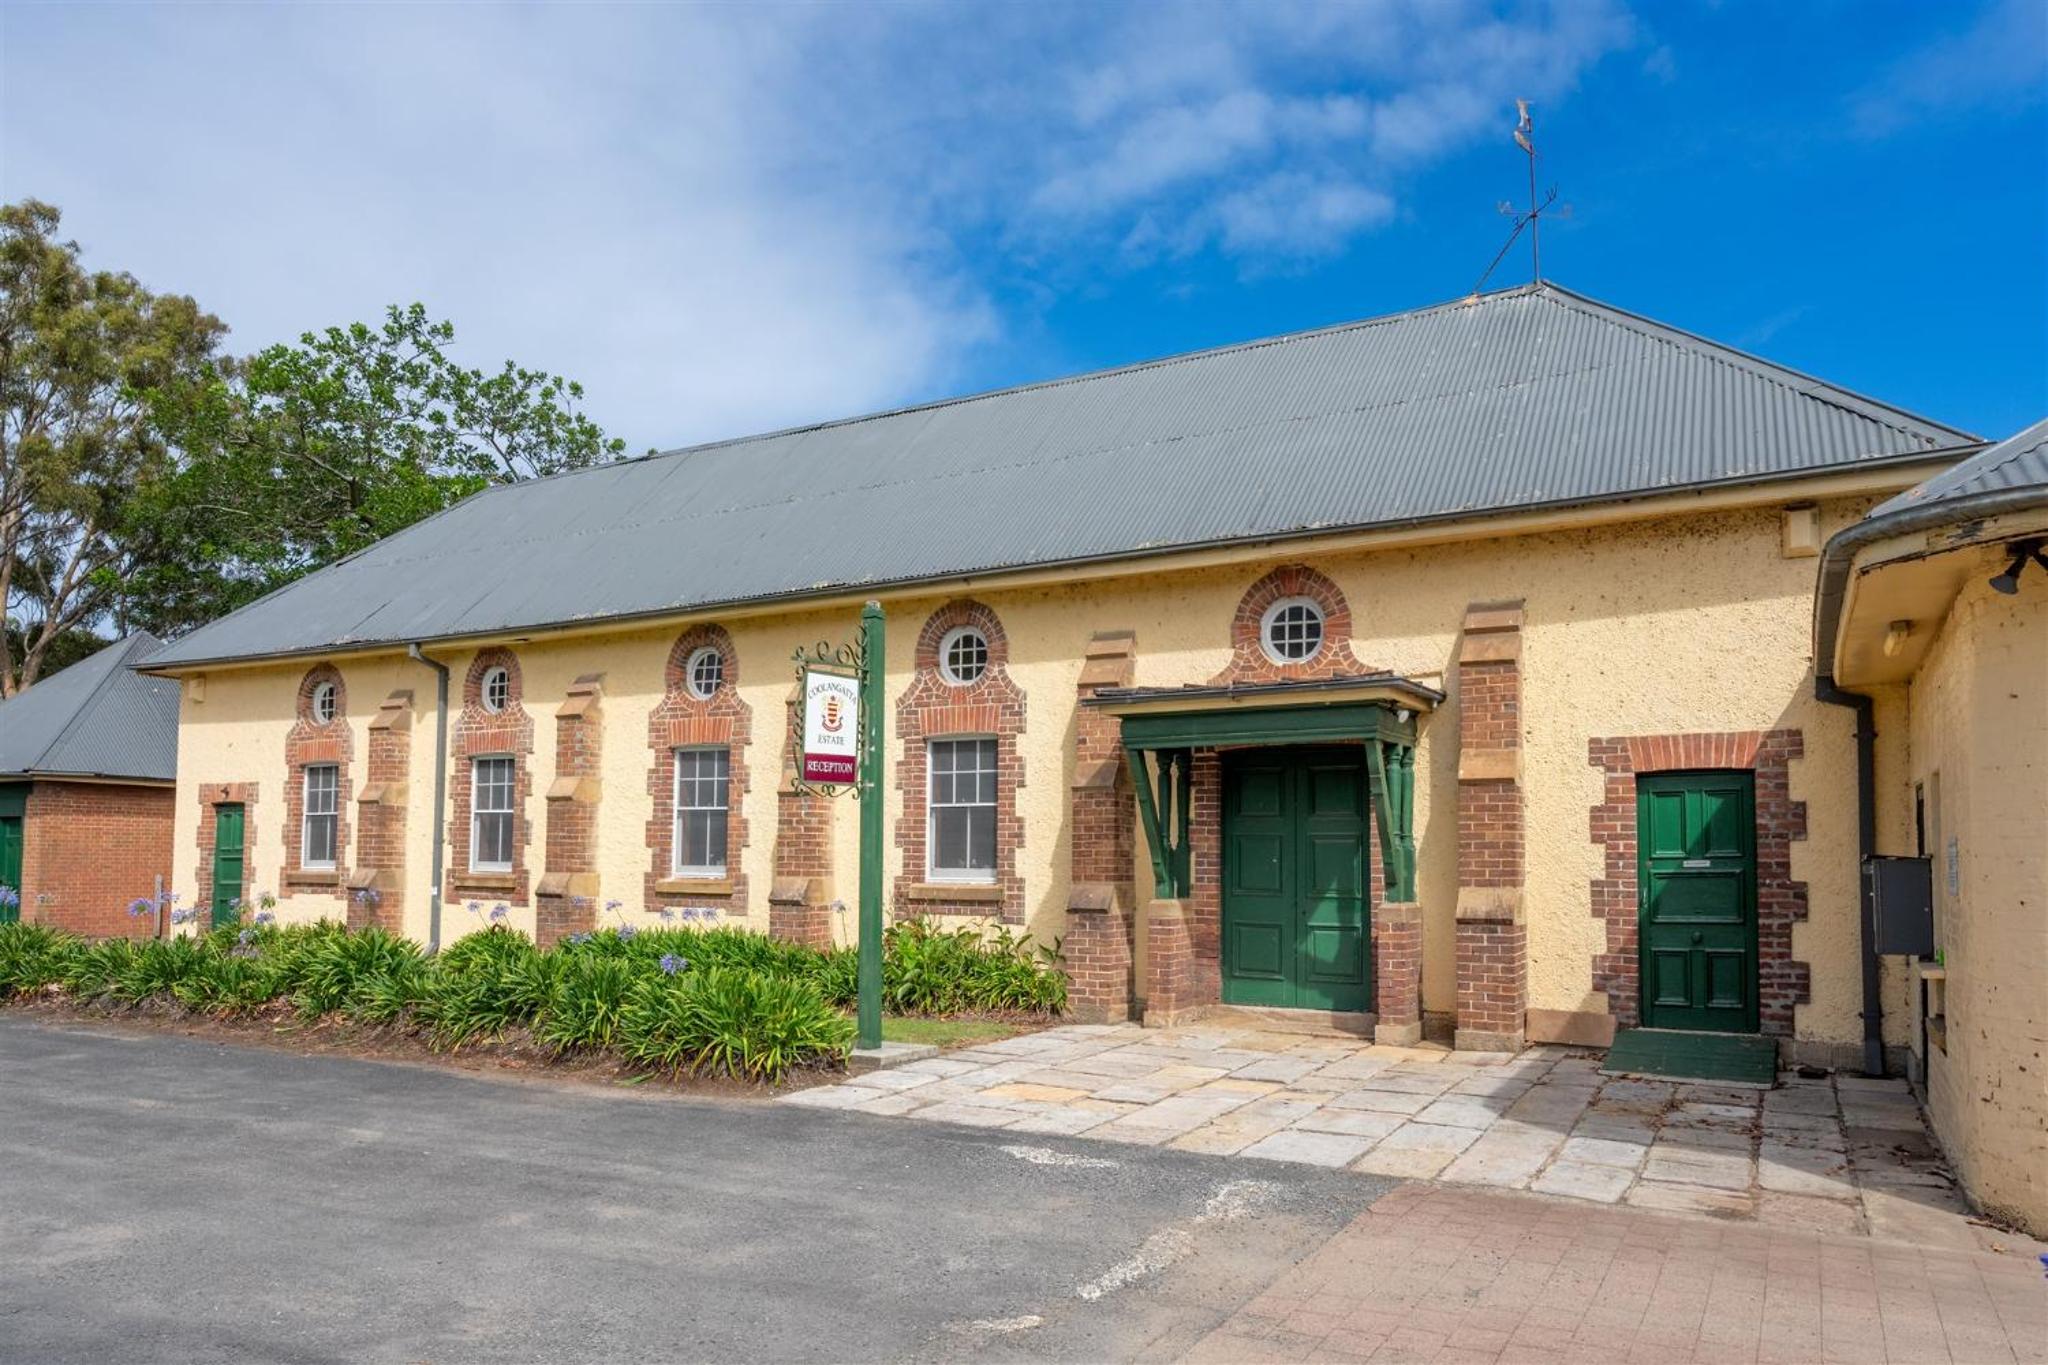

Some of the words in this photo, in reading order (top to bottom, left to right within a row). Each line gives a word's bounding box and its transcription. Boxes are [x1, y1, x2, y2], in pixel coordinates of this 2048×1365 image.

[808, 681, 857, 705] COOLANGATTA
[817, 735, 845, 745] ESTATE
[807, 761, 853, 774] RECEPTION
